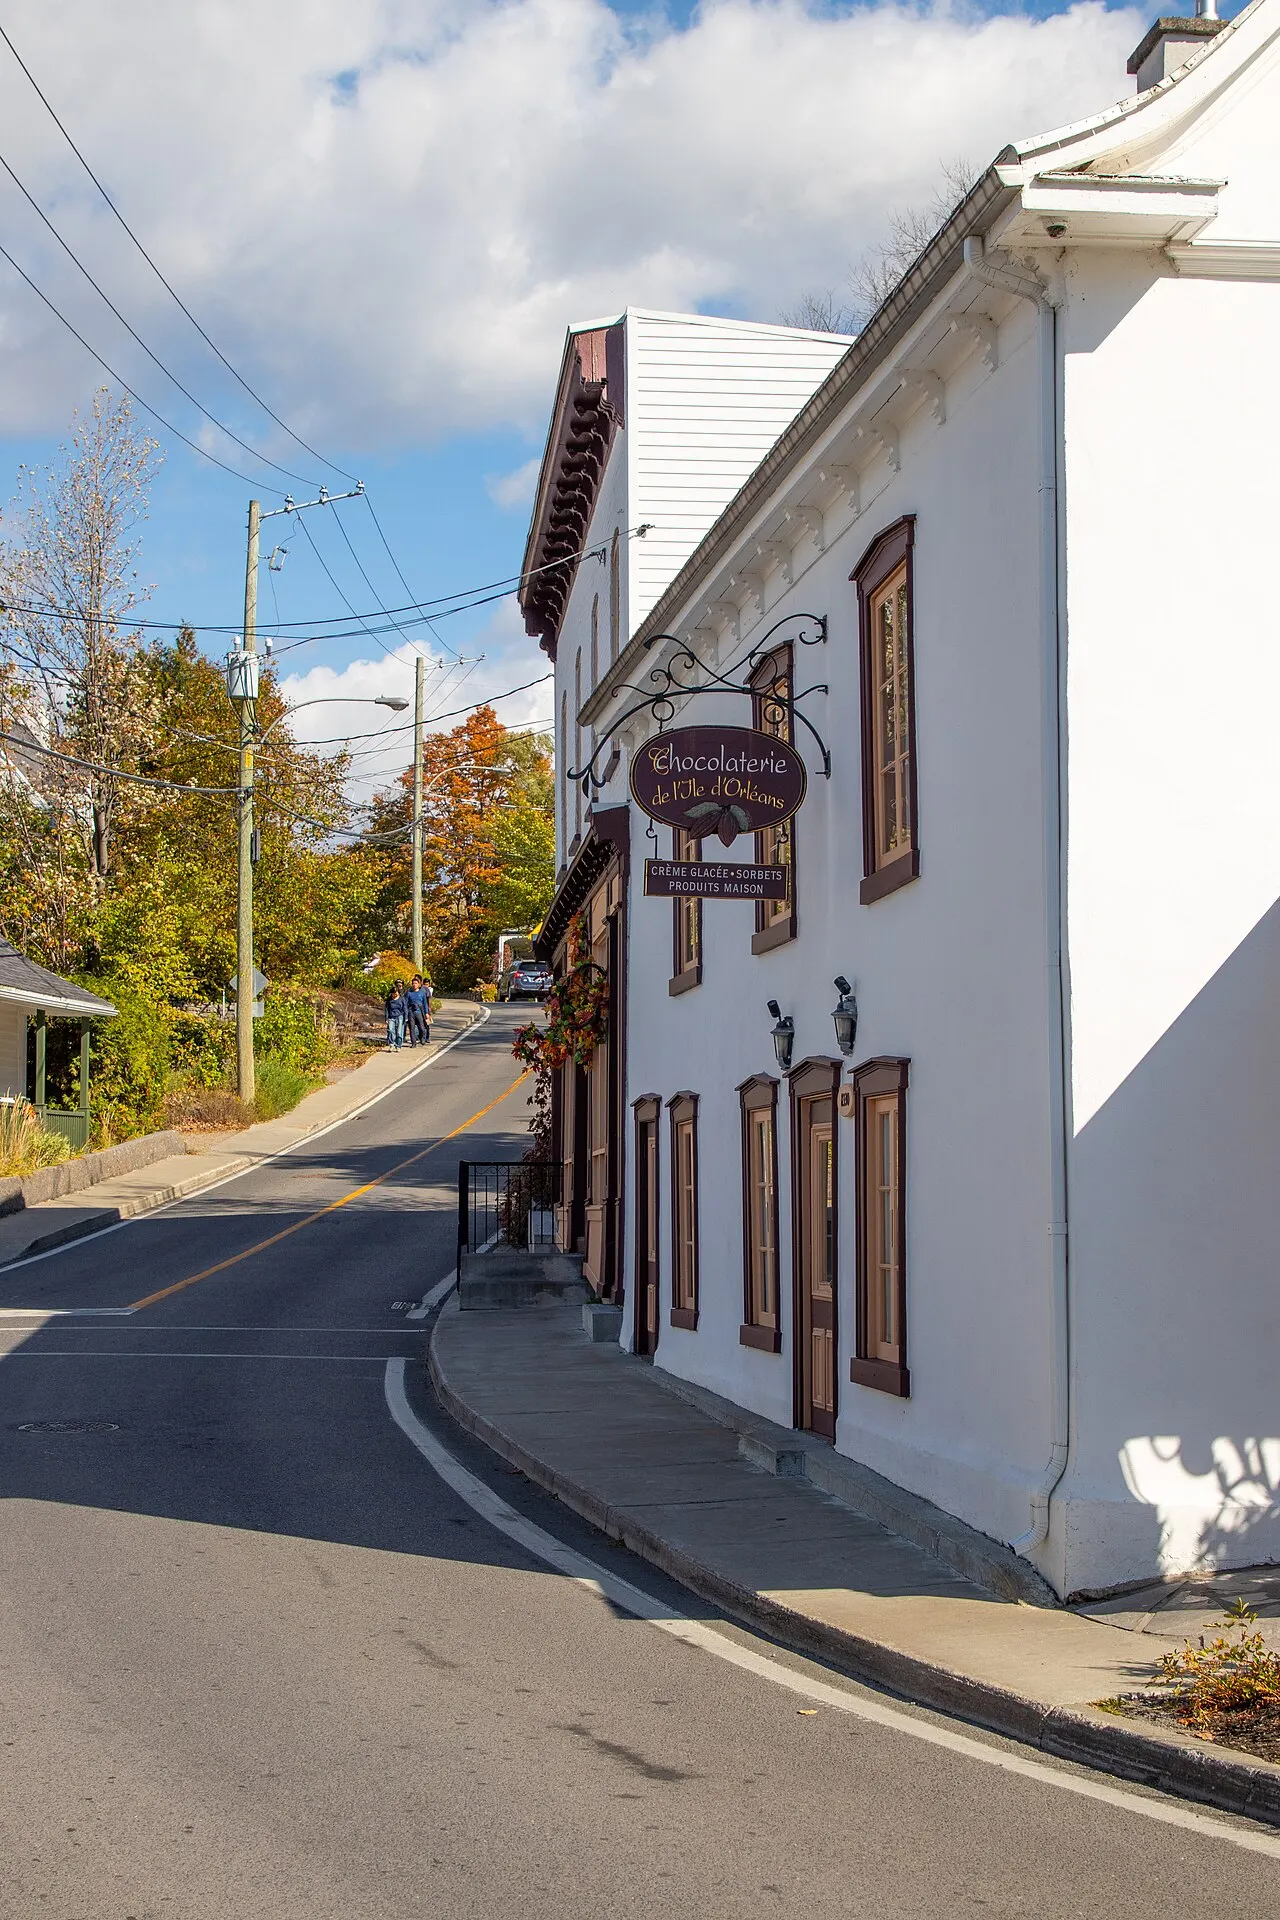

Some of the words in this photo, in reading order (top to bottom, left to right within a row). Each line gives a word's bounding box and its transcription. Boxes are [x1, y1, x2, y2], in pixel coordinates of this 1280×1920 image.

[648, 742, 788, 776] Chocolaterie
[652, 784, 670, 805] de
[711, 775, 785, 809] d'Orléans
[651, 863, 687, 877] CRÈME
[736, 869, 782, 880] SORBETS
[669, 881, 720, 892] PRODUITS
[724, 883, 764, 894] MAISON
